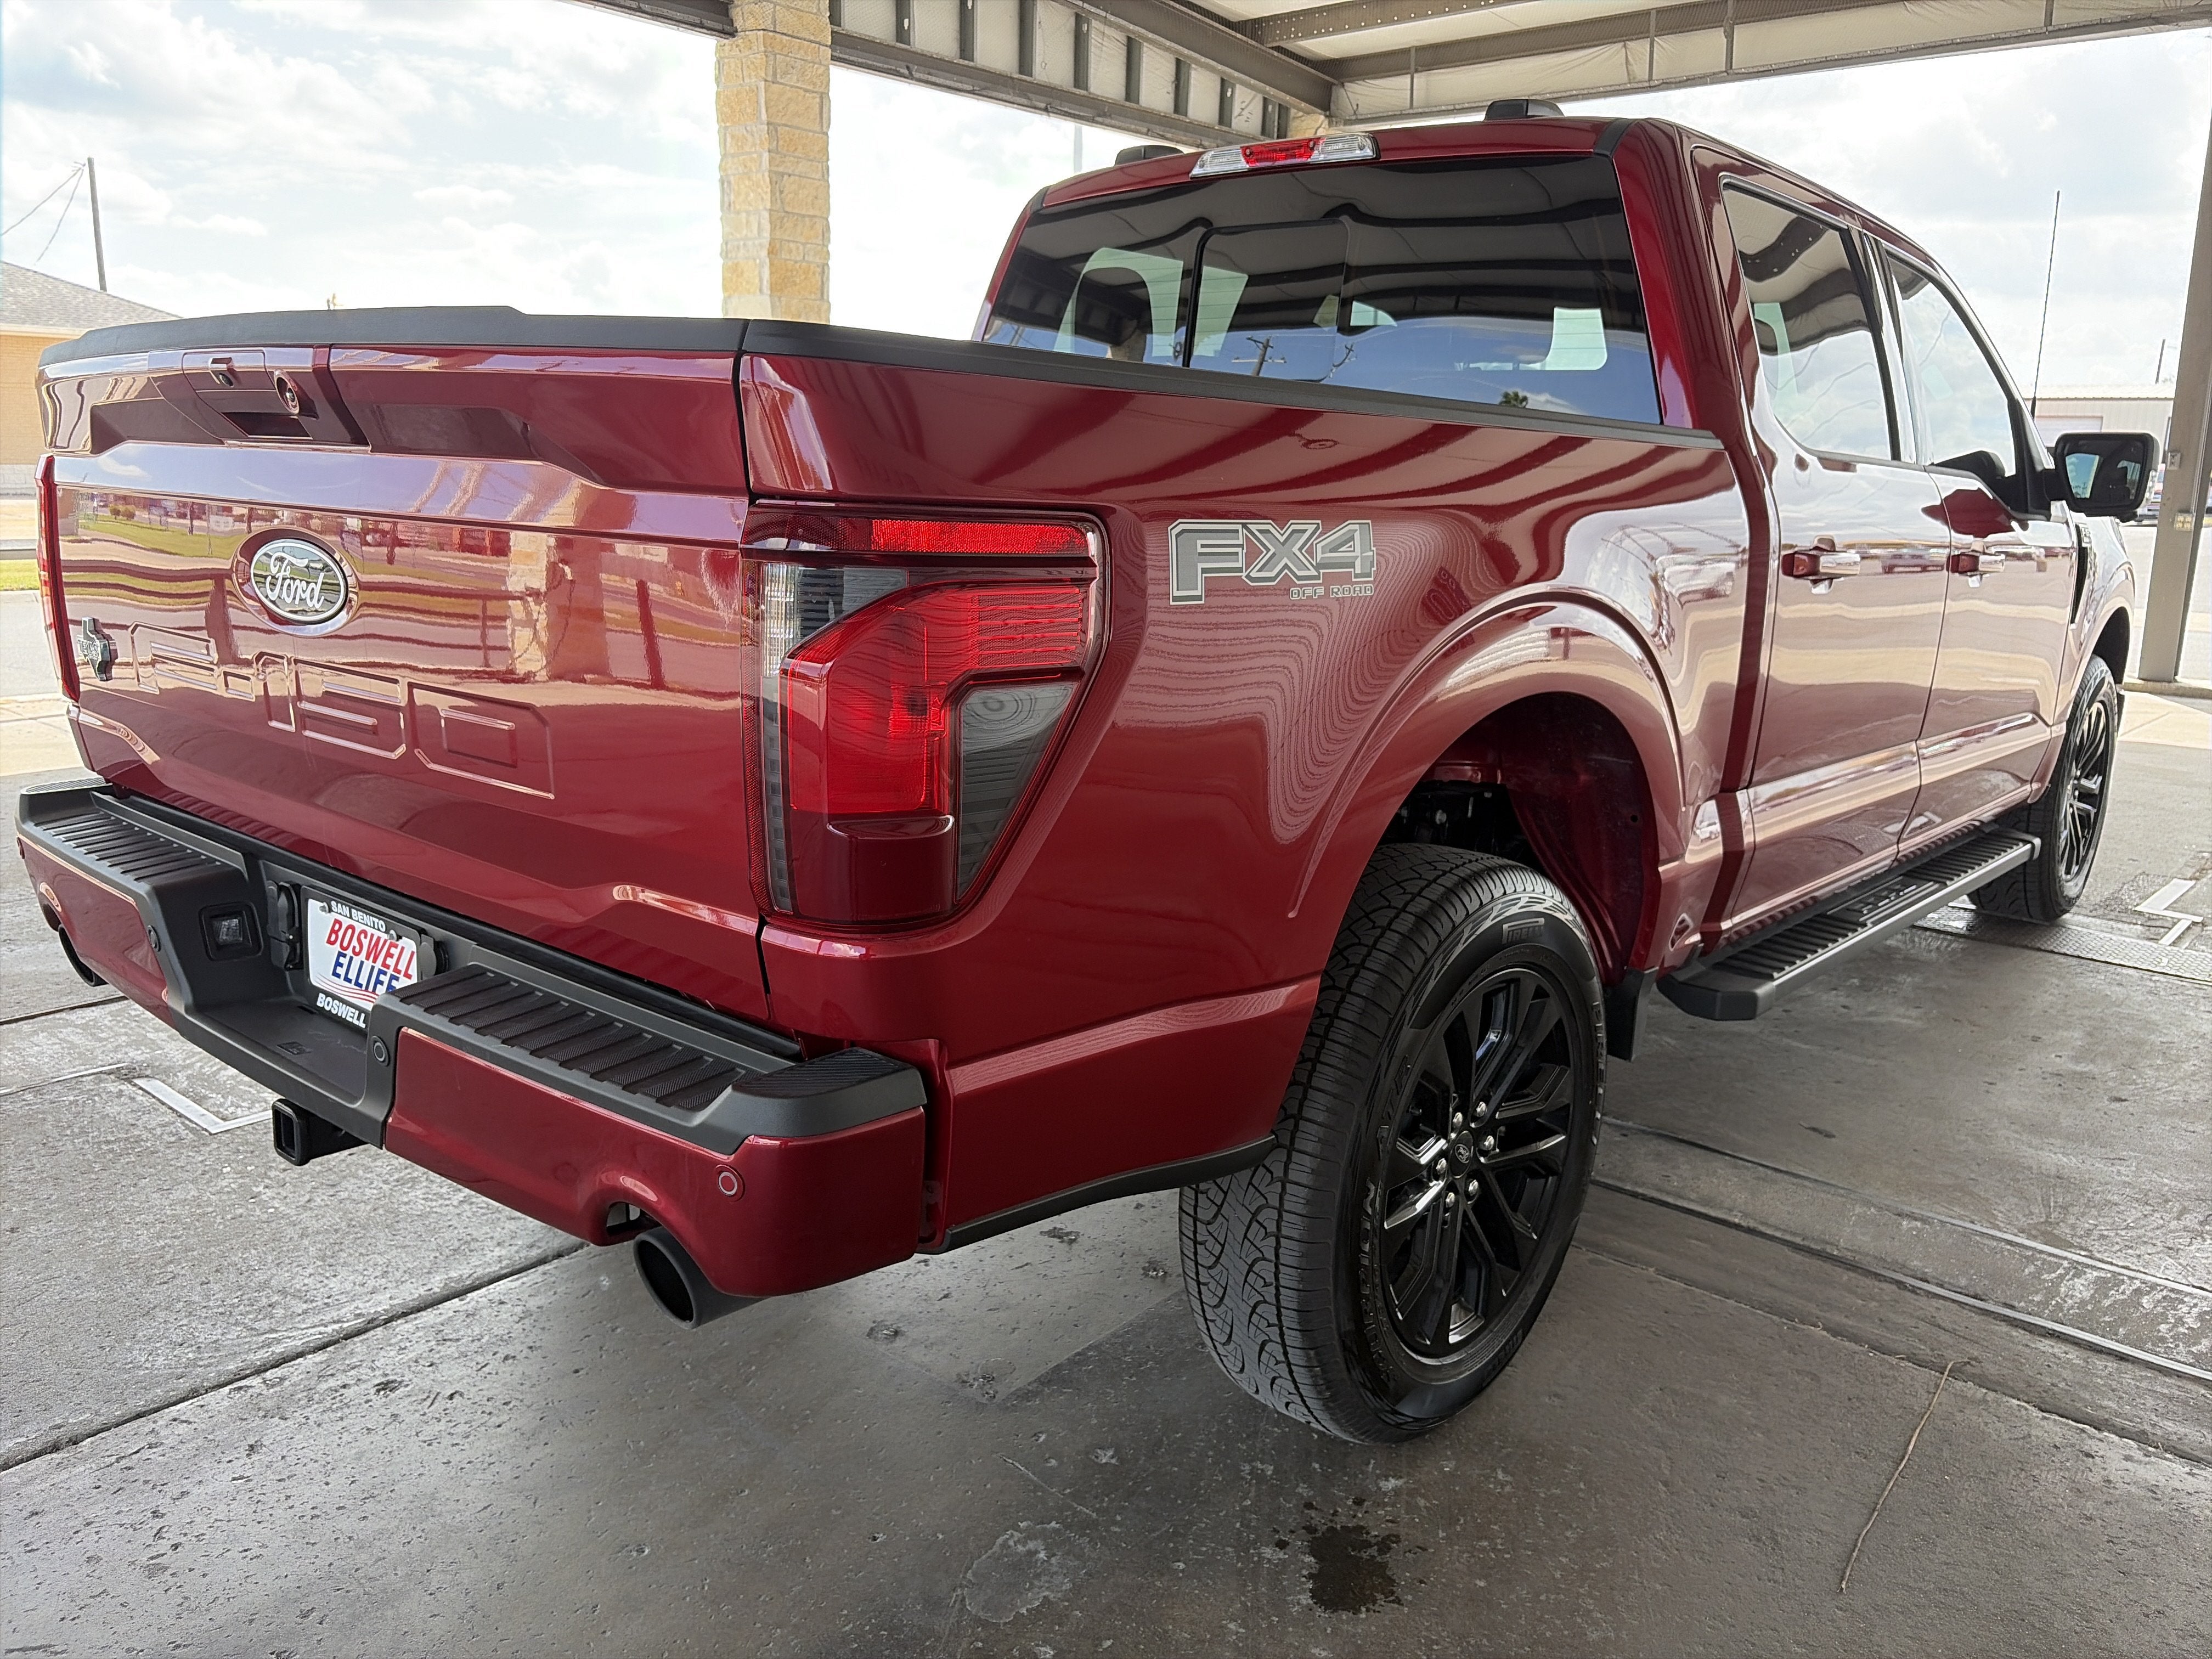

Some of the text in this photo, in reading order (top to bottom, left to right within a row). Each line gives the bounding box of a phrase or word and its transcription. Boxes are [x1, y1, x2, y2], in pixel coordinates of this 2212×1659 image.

[266, 551, 325, 609] Ford
[1168, 518, 1376, 605] FX4
[1289, 584, 1374, 600] OFF ROAD
[128, 620, 555, 800] F-150
[331, 900, 386, 932] SAN BENITO
[326, 918, 417, 980] BOSWELL
[317, 992, 366, 1029] BOSWELL
